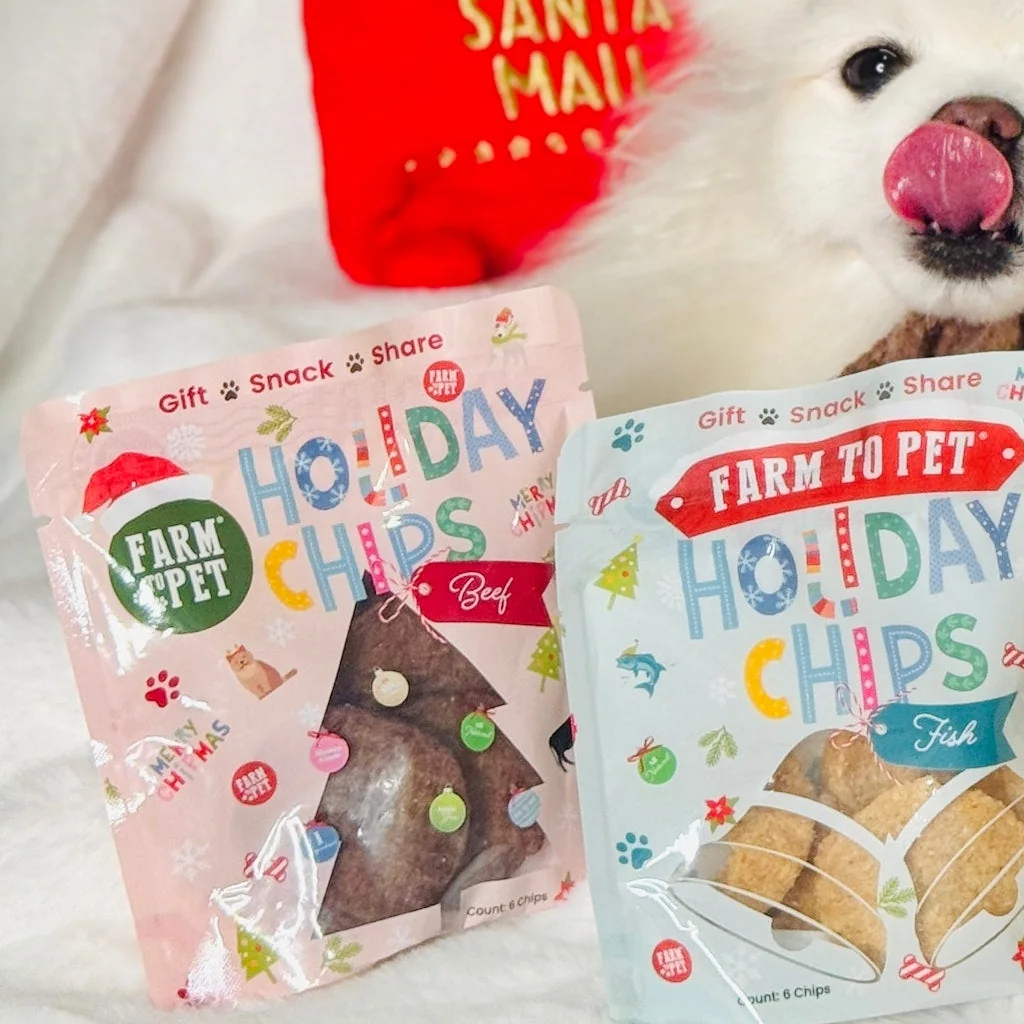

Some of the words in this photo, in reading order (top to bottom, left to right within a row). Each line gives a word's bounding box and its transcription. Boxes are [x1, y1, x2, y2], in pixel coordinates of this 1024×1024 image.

[159, 386, 209, 413] Gift
[250, 359, 336, 394] Snack
[371, 333, 444, 365] Share
[699, 405, 746, 430] Gift
[790, 390, 866, 424] Snack
[903, 372, 982, 395] Share
[238, 378, 546, 537] HOLIDAY
[709, 450, 824, 513] FARM
[838, 434, 883, 483] TO
[897, 430, 975, 476] PET
[124, 518, 225, 574] FARM
[264, 497, 486, 613] CHIPS
[678, 493, 1021, 640] HOLIDAY
[164, 558, 231, 609] PET
[449, 572, 514, 615] Beef
[744, 613, 988, 725] CHIPS
[913, 713, 978, 752] Fish
[466, 904, 506, 916] Count:
[509, 900, 516, 910] 6
[517, 893, 548, 906] Chips
[783, 988, 791, 1000] 6
[794, 984, 831, 999] Chips
